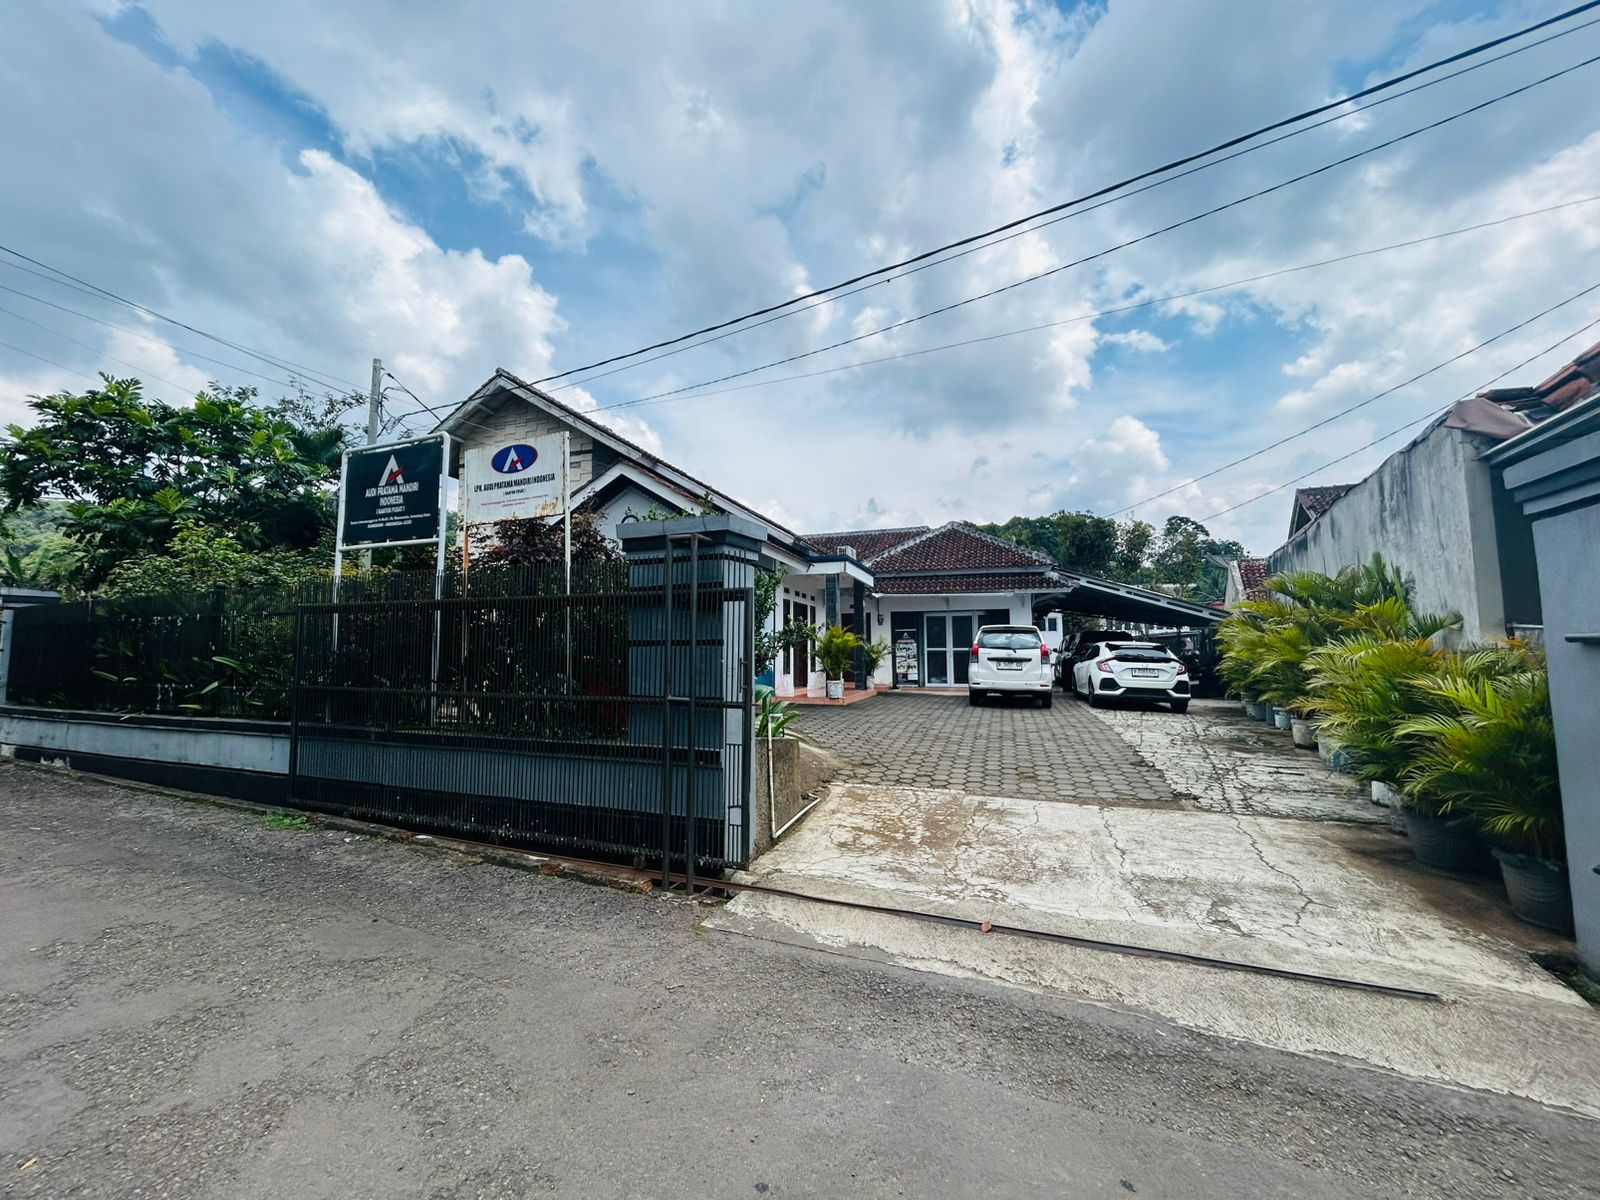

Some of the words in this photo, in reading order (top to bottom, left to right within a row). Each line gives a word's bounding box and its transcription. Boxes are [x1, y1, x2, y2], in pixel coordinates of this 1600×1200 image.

[365, 488, 377, 498] AUDI
[377, 485, 398, 496] PRATAMA
[399, 482, 419, 493] MANDIRI
[484, 482, 493, 491] AUDI
[494, 480, 513, 490] PRATAMA
[514, 476, 531, 487] MANDIRI
[532, 473, 555, 484] INDONESIA
[379, 495, 404, 506] INDONESIA
